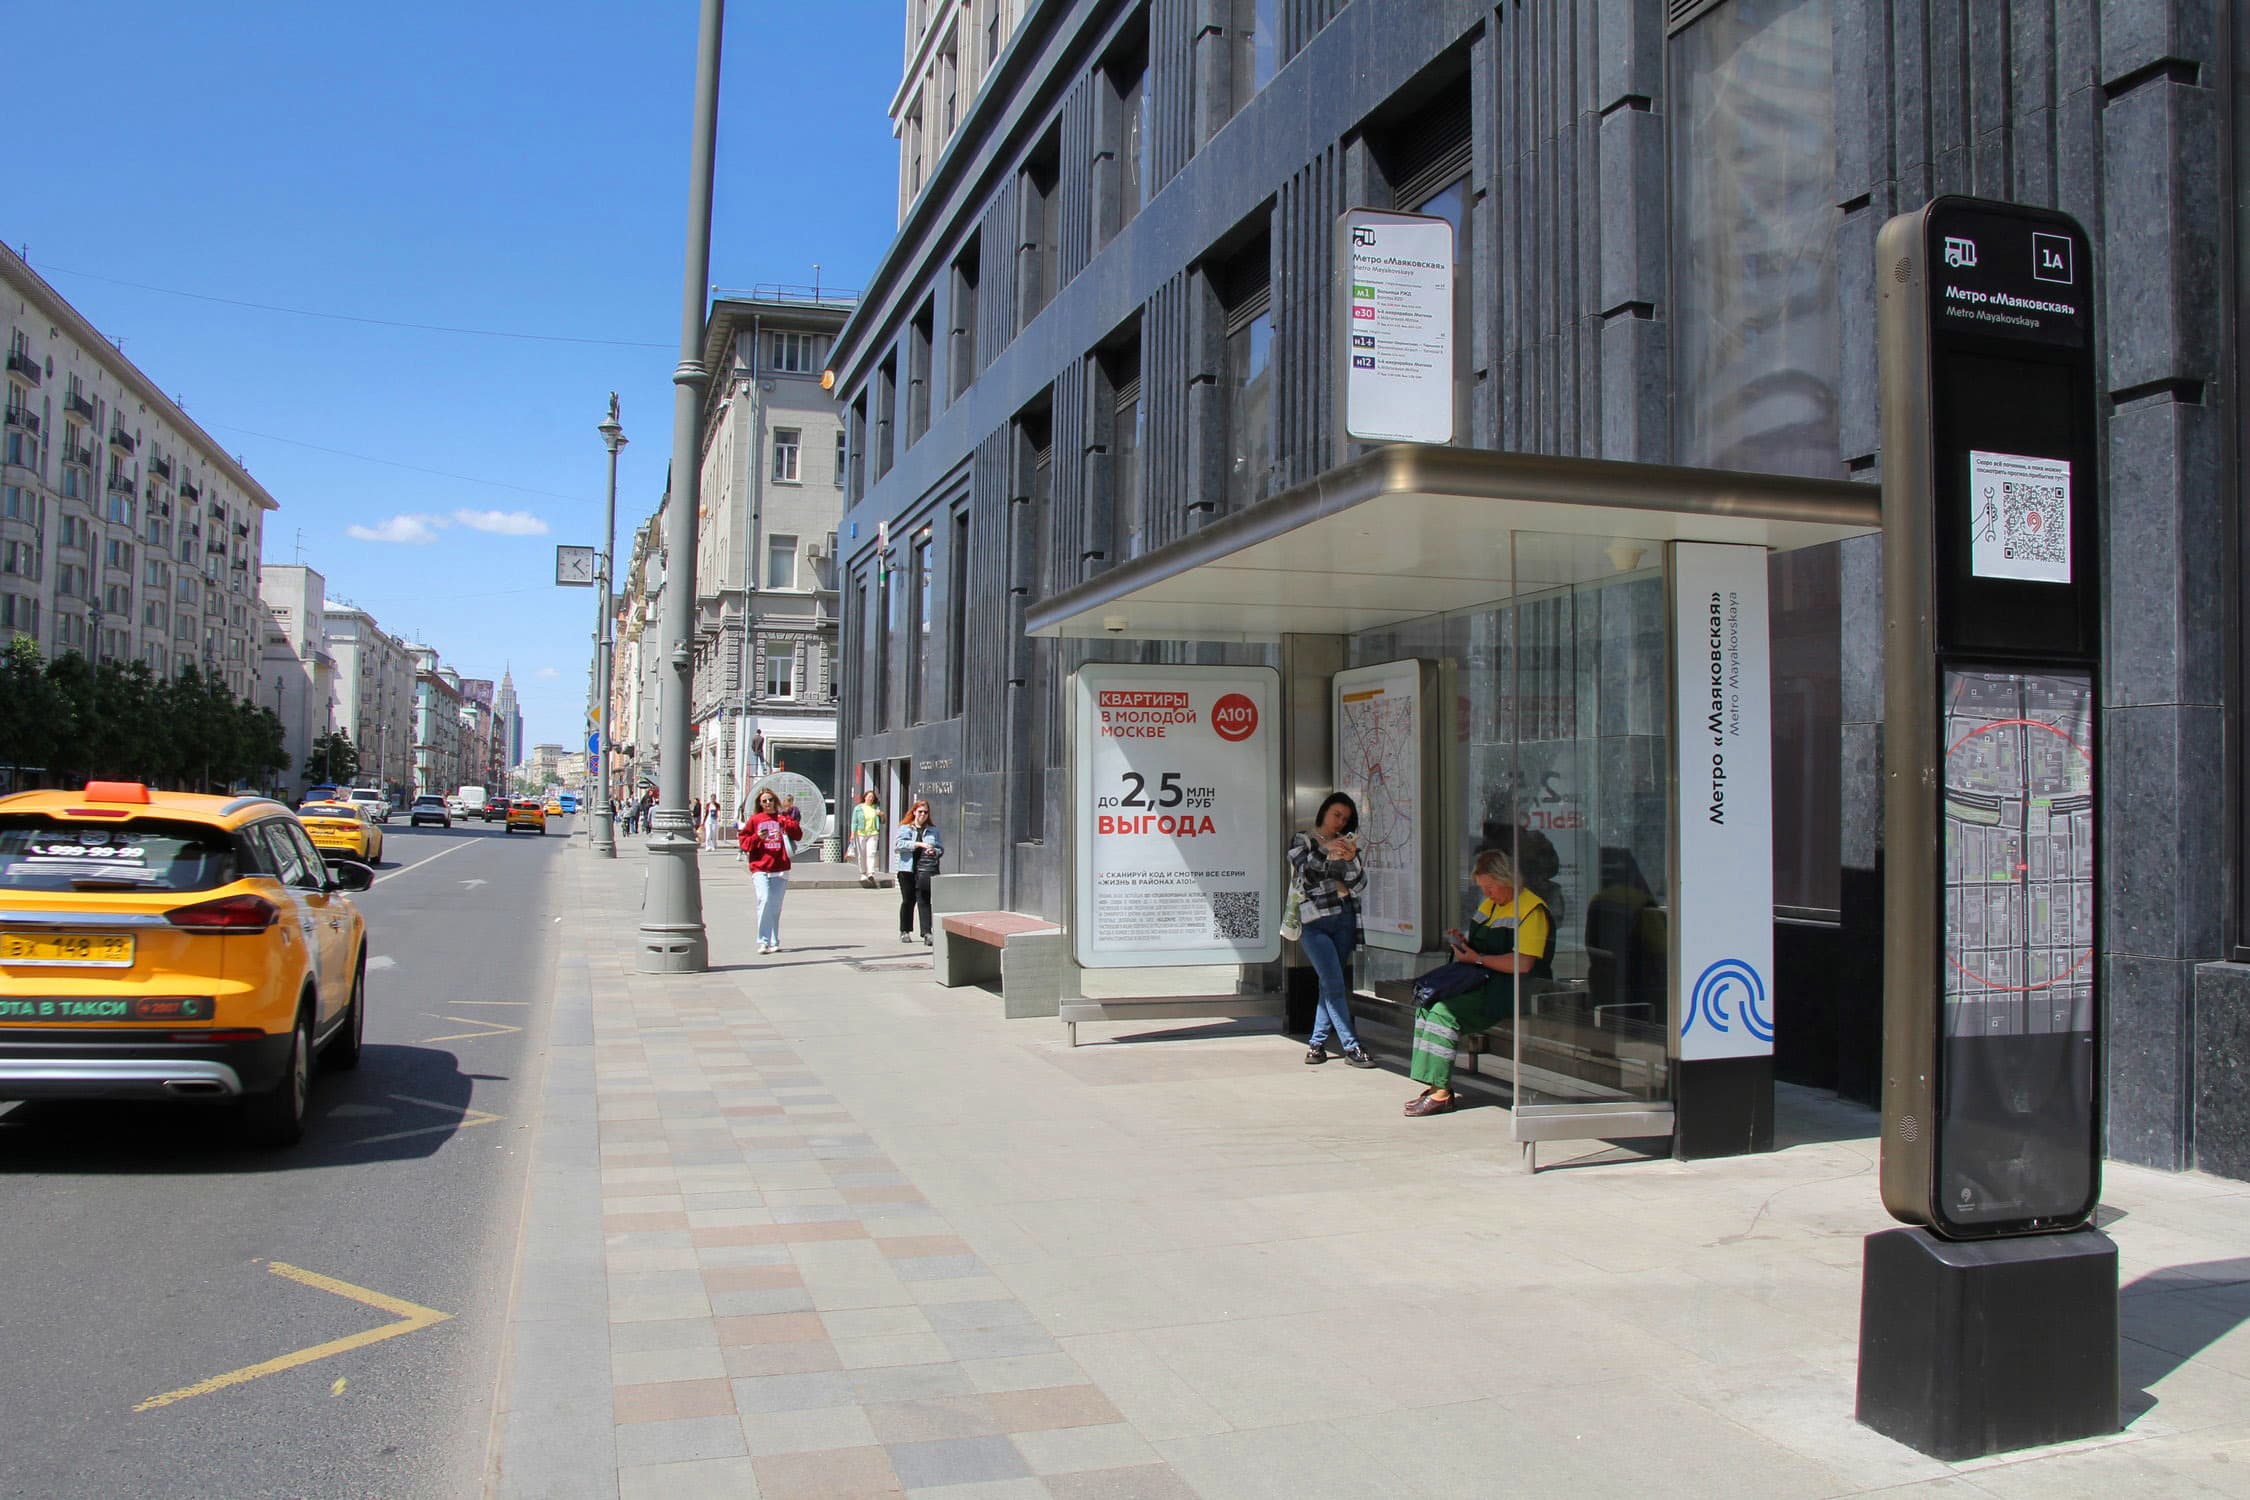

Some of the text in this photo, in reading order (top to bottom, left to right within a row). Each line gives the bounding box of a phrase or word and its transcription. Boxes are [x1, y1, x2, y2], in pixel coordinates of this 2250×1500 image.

[1353, 254, 1445, 270] Метро «Маяковская»
[1946, 285, 2075, 315] Метро «Маяковская»
[1946, 306, 2040, 329] Metro Mayakovskaya
[1727, 591, 1740, 736] Metro Mayakovskaya
[1101, 693, 1187, 706] КВАРТИРЫ
[1217, 707, 1252, 721] А101
[1708, 591, 1726, 825] Метро «Маяковская»
[1102, 709, 1197, 725] В МОЛОДОЙ
[1101, 726, 1166, 737] МОСКВЕ
[1121, 771, 1183, 812] 2,5
[1186, 788, 1215, 797] МЛН
[1099, 815, 1216, 837] ВЫГОДА
[47, 844, 145, 857] 999-99-99
[1106, 870, 1146, 878] СКАНИРУЙ
[39, 1001, 55, 1015] В
[59, 1001, 127, 1015] ТАКСИ
